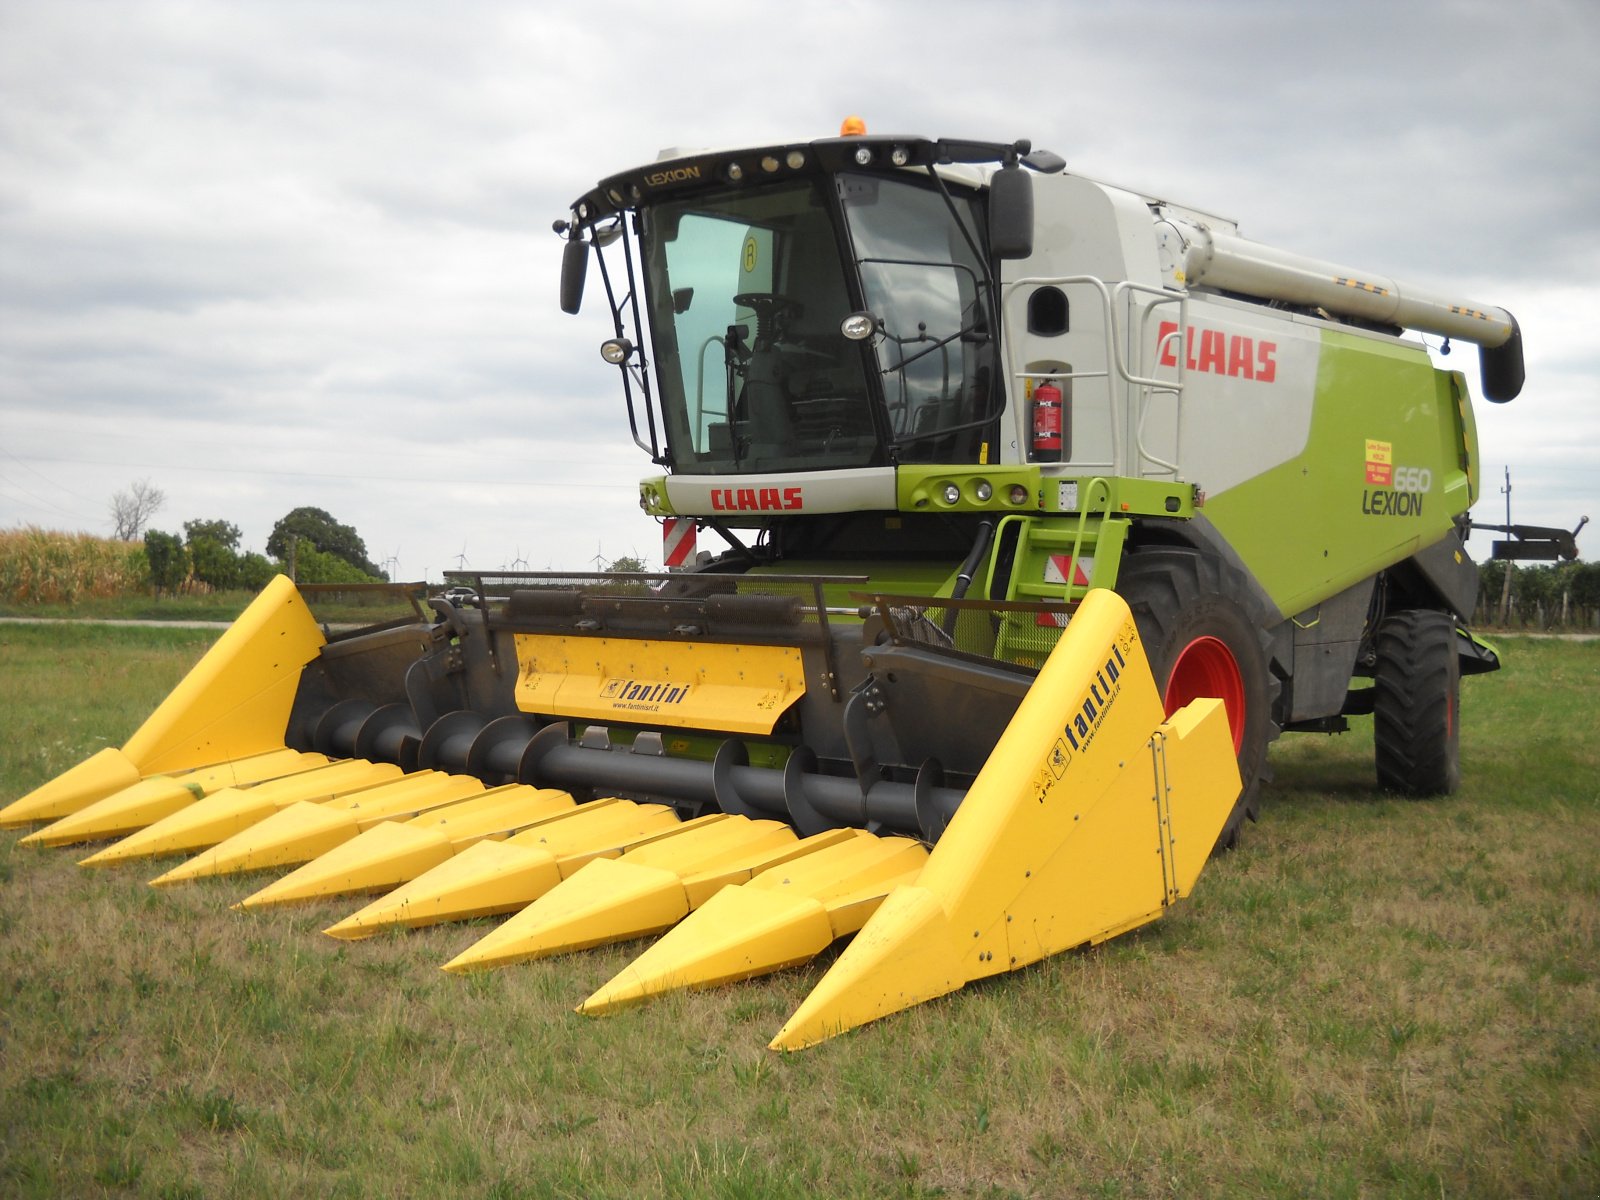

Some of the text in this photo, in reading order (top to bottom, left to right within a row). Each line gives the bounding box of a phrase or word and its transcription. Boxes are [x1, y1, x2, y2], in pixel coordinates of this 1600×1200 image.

[644, 166, 701, 186] LEXION
[1156, 321, 1277, 383] CLAAS
[1394, 466, 1431, 493] 660
[711, 487, 803, 511] CLAAS
[1362, 490, 1423, 516] LEXION
[619, 680, 691, 704] fantini
[1065, 643, 1126, 751] fantini
[612, 702, 660, 712] www.fantinisrl.it
[1081, 683, 1121, 753] www.fantinisrl.it
